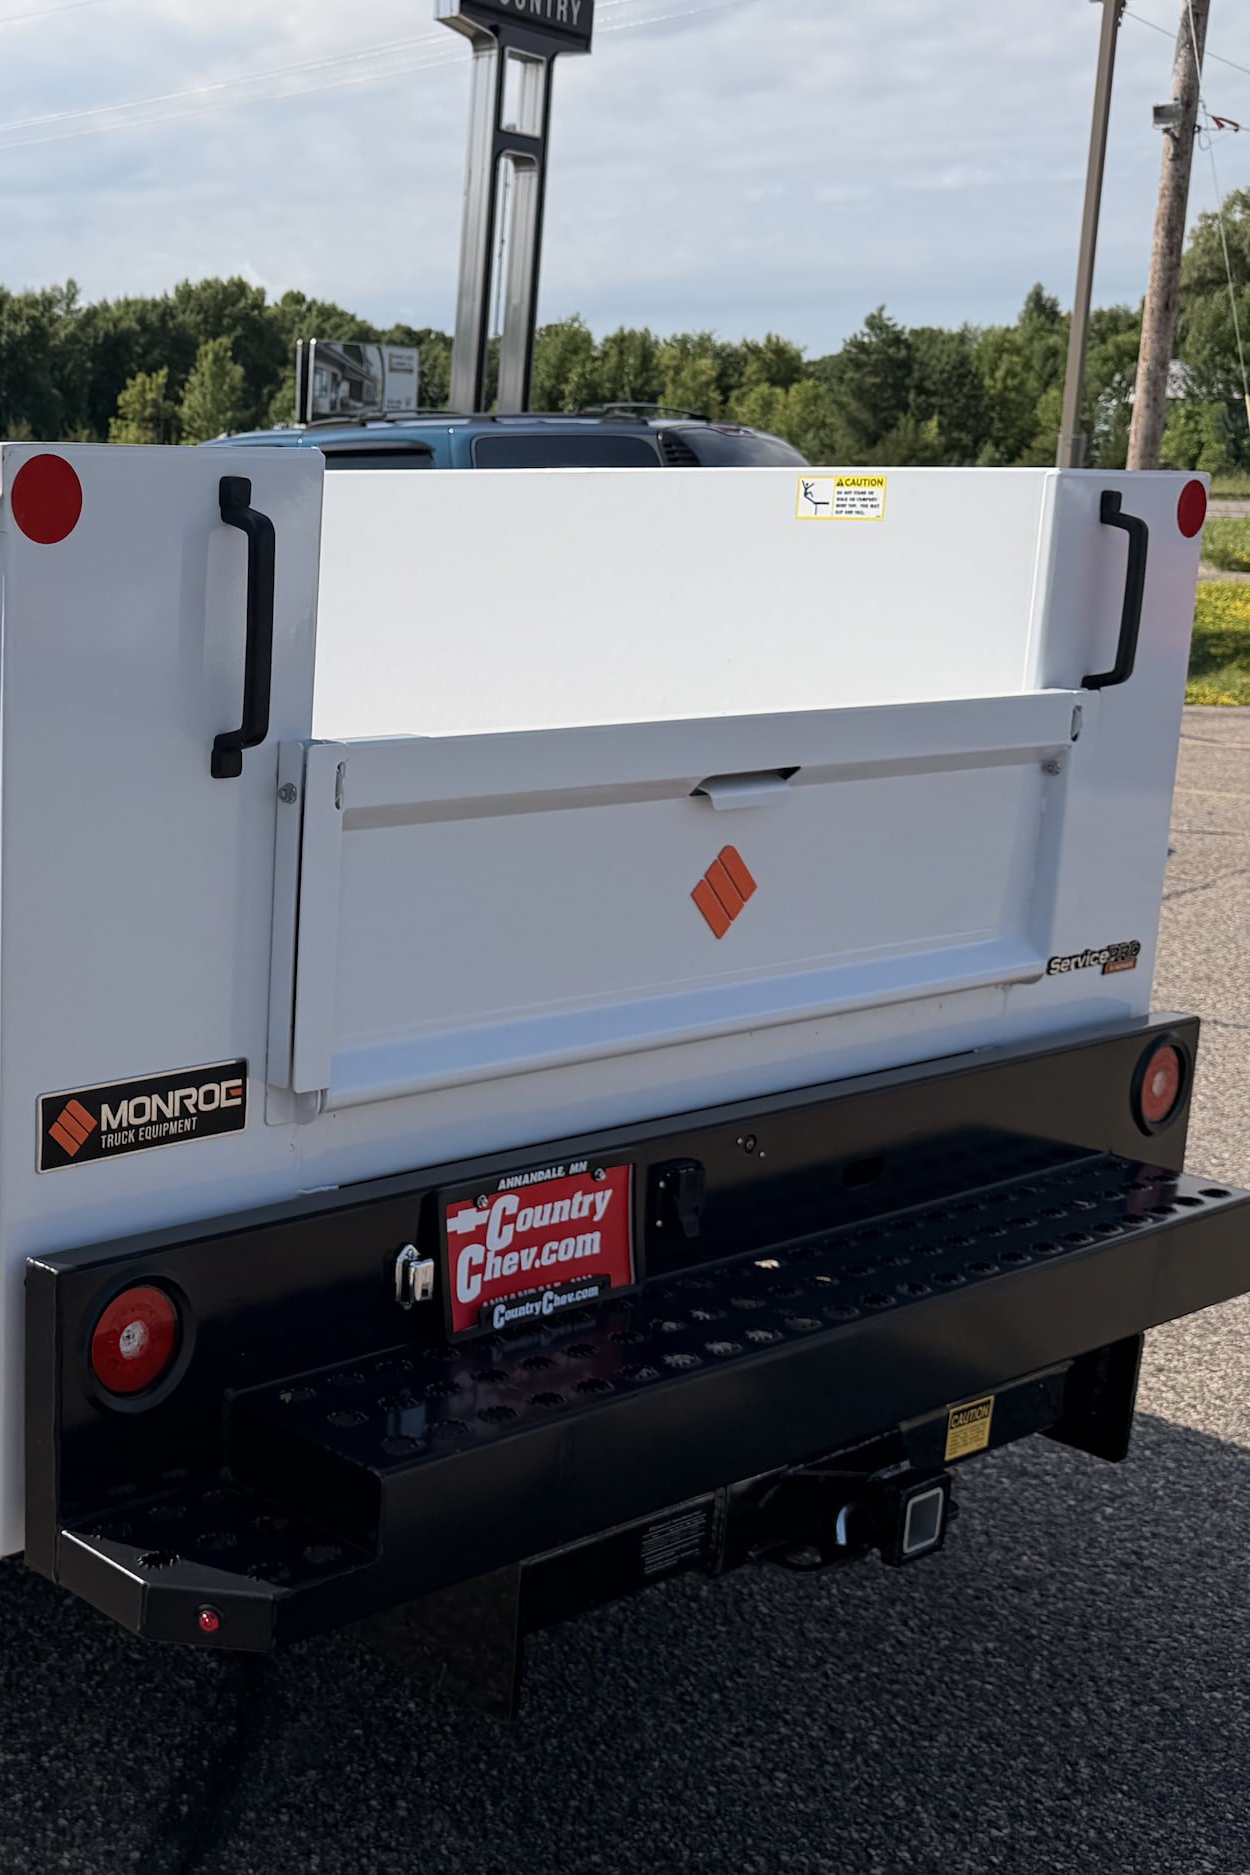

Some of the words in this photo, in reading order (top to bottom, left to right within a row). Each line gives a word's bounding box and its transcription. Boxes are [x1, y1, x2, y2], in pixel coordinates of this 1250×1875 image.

[500, 0, 581, 26] UNTRY
[845, 478, 883, 487] CAUTION
[100, 1078, 243, 1132] MONROE
[101, 1130, 136, 1149] TRUCK
[138, 1116, 198, 1141] EQUIPMENT
[569, 1161, 588, 1175] MN
[486, 1188, 613, 1251] Country
[456, 1231, 602, 1304] Chev.com
[493, 1285, 599, 1329] CountryChev.com
[951, 1403, 990, 1427] CAUTION
